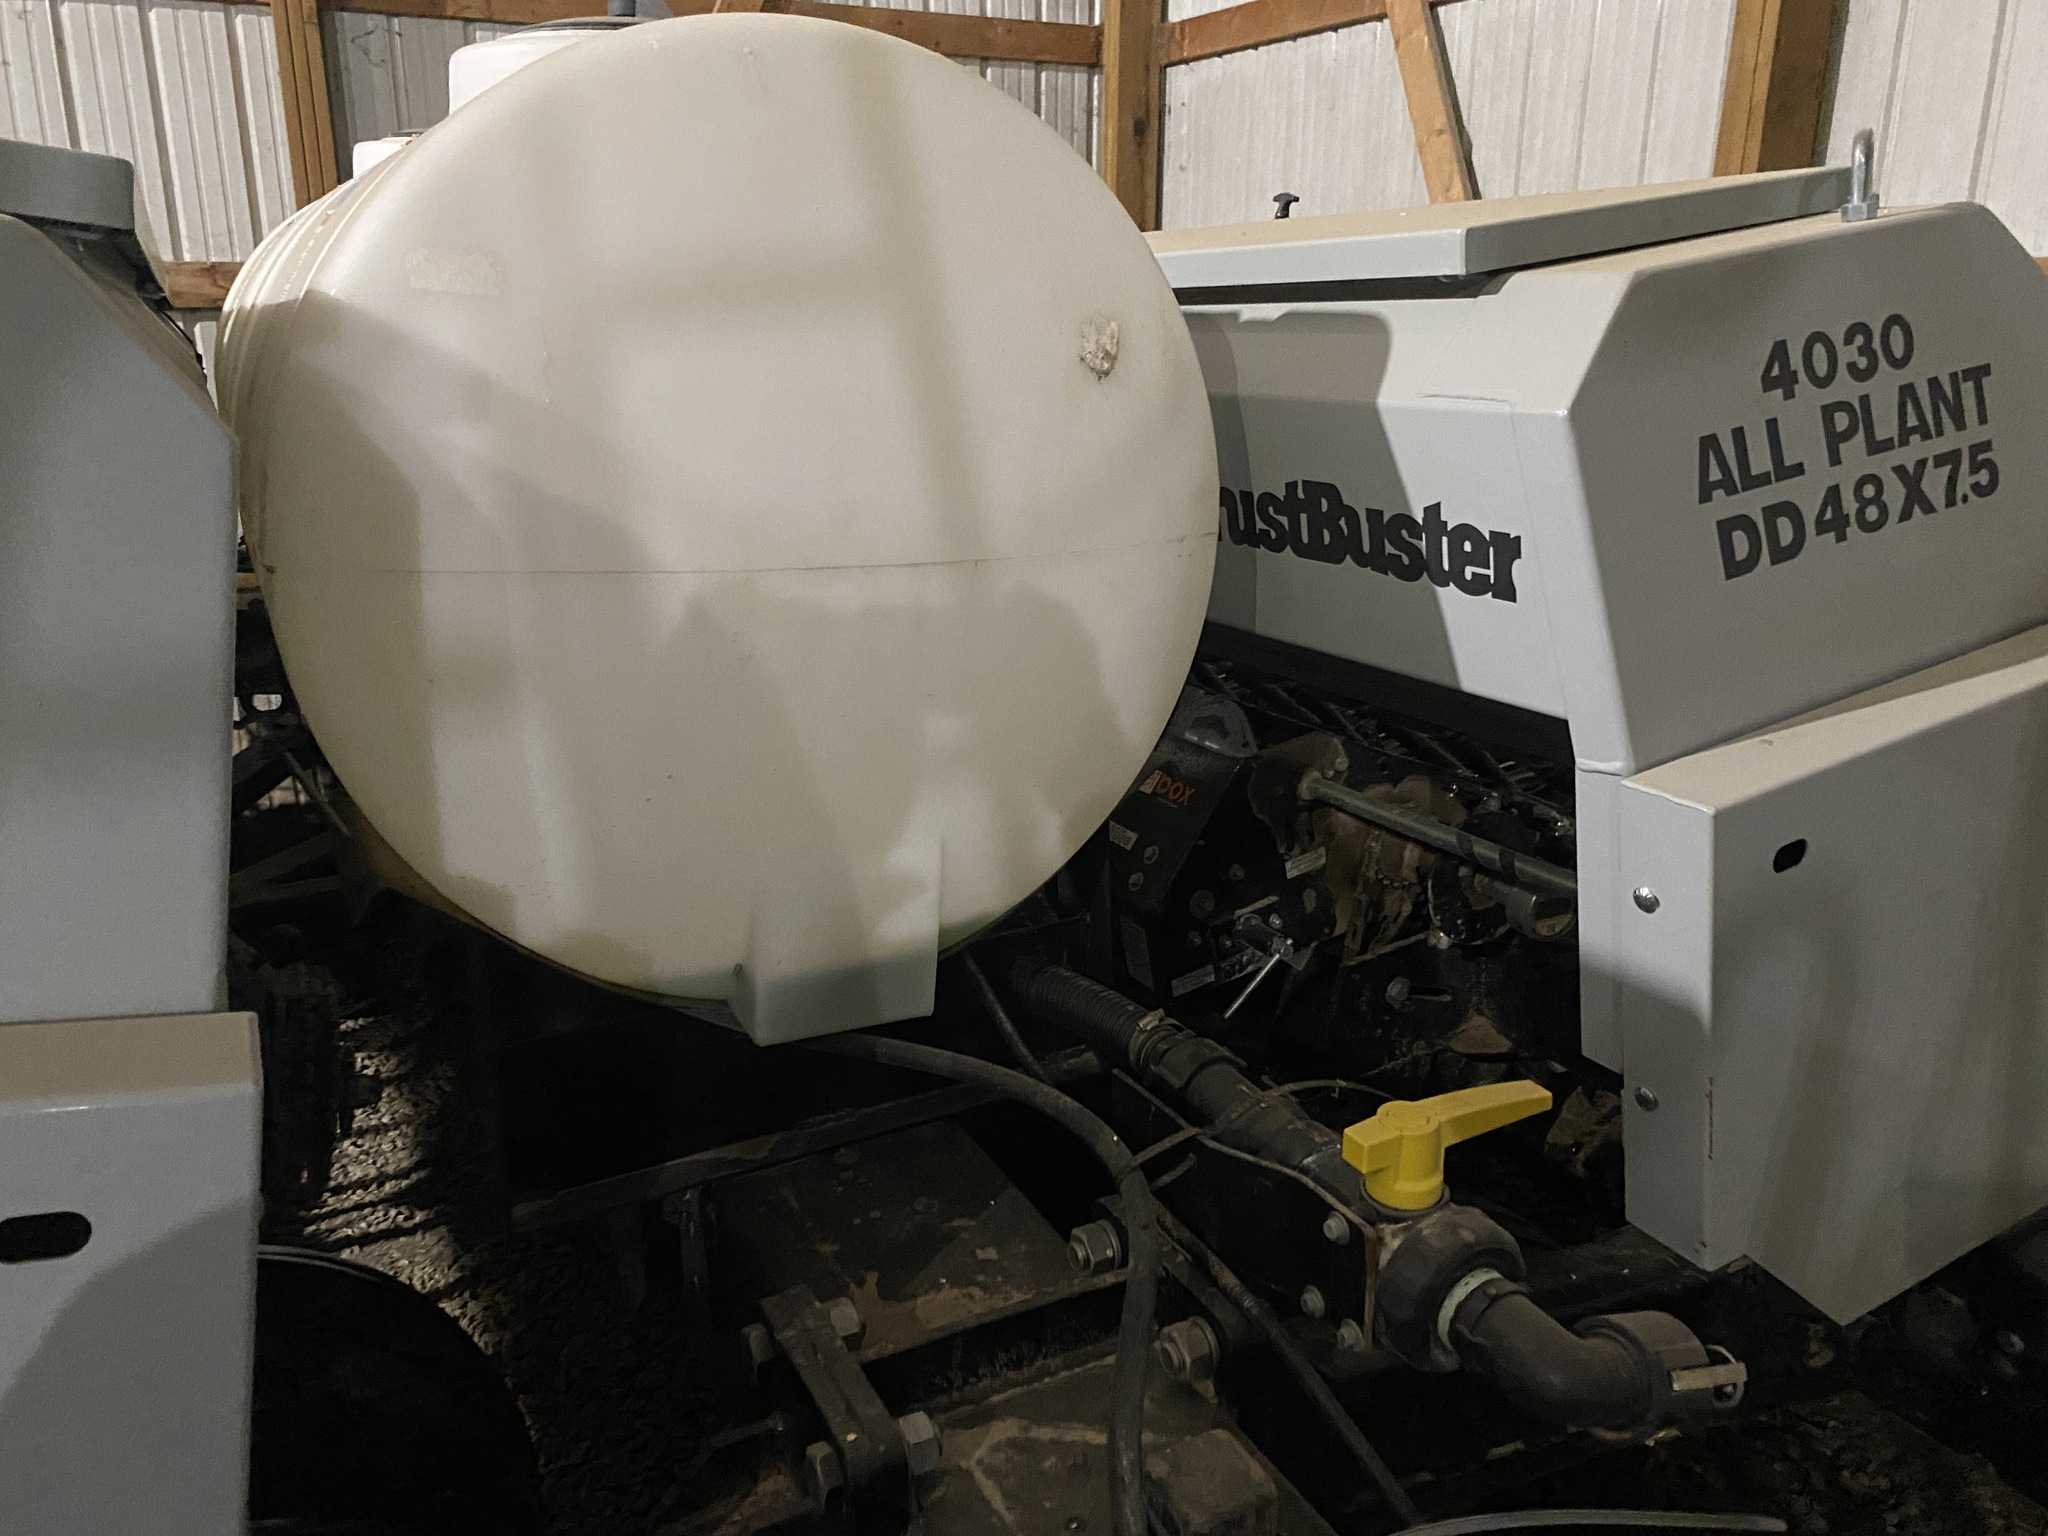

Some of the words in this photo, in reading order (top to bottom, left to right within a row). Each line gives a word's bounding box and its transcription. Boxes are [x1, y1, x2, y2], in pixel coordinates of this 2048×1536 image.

[1761, 313, 1914, 400] 4030
[1698, 417, 1805, 505] ALL
[1820, 363, 1991, 467] PLANT
